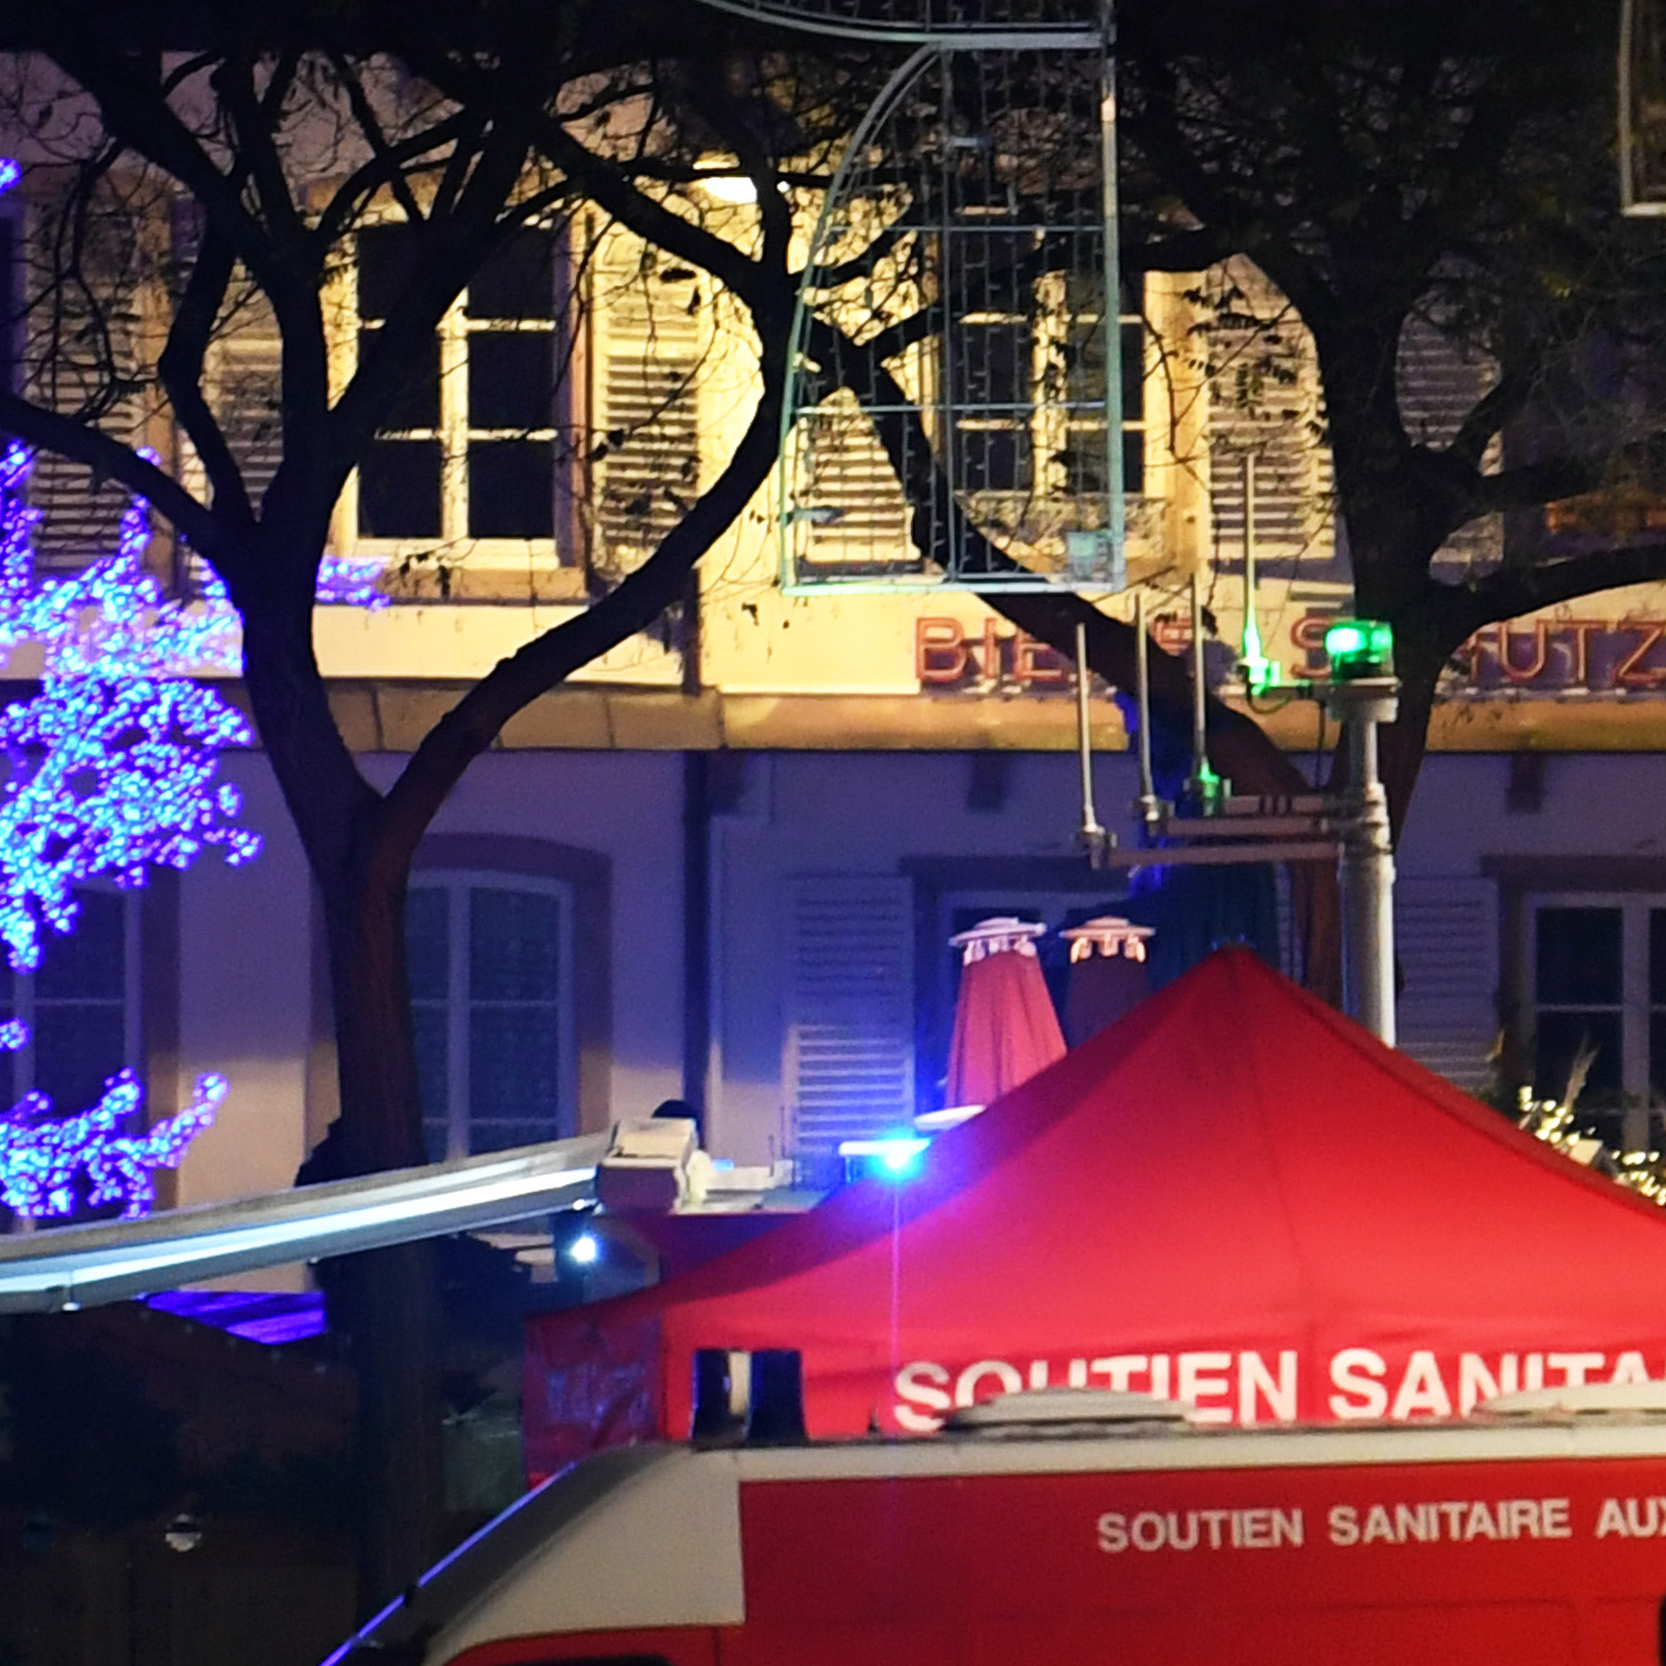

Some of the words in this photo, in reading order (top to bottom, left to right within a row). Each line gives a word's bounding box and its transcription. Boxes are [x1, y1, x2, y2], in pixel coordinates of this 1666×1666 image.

[913, 615, 1197, 682] BIEE
[1096, 1507, 1305, 1554] SOUTIEN
[1327, 1497, 1573, 1547] SANITAIRE
